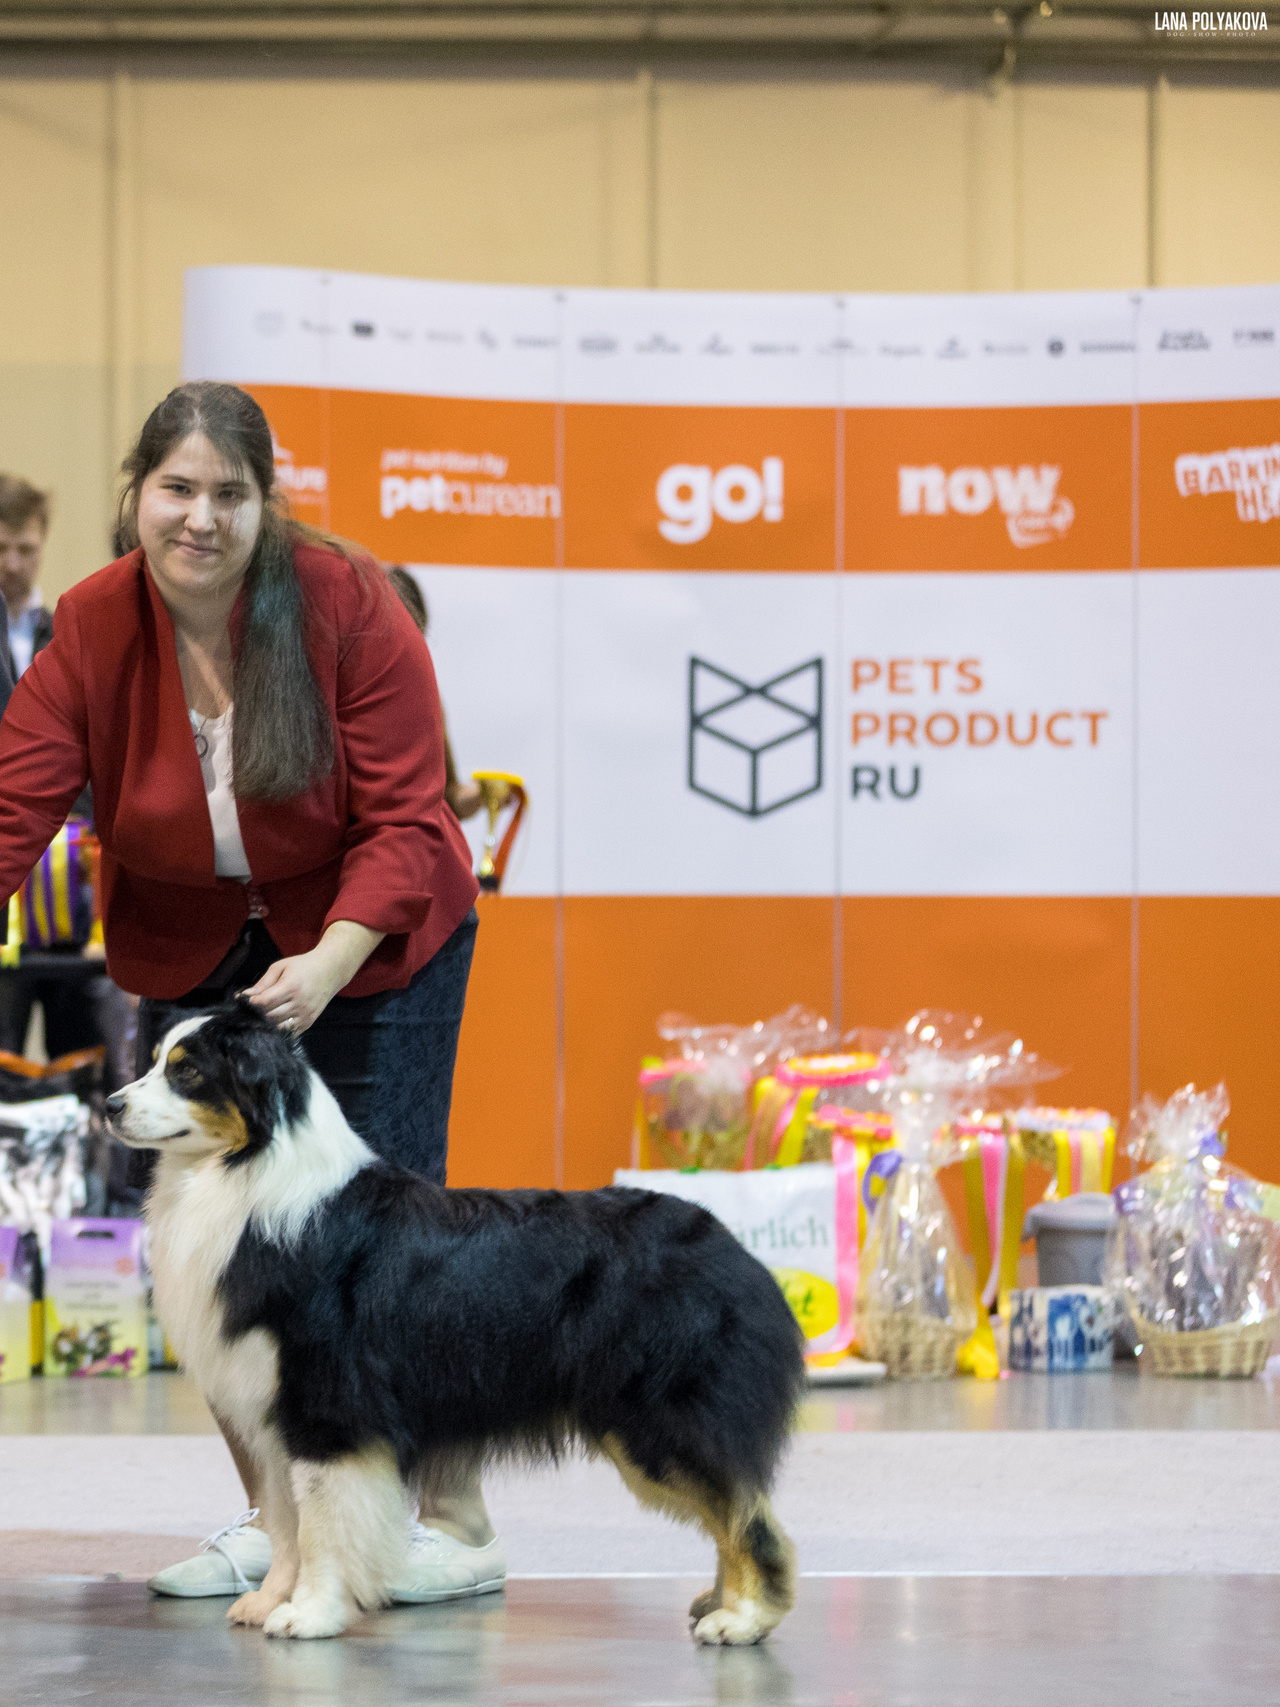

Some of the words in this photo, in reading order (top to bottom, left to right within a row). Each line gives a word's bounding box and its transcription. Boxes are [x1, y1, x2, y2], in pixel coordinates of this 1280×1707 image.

[380, 475, 561, 519] petcurean
[656, 456, 784, 545] go!
[898, 464, 1062, 517] now
[850, 658, 983, 695] PETS
[850, 711, 1109, 748] PRODUCT
[850, 764, 921, 801] RU
